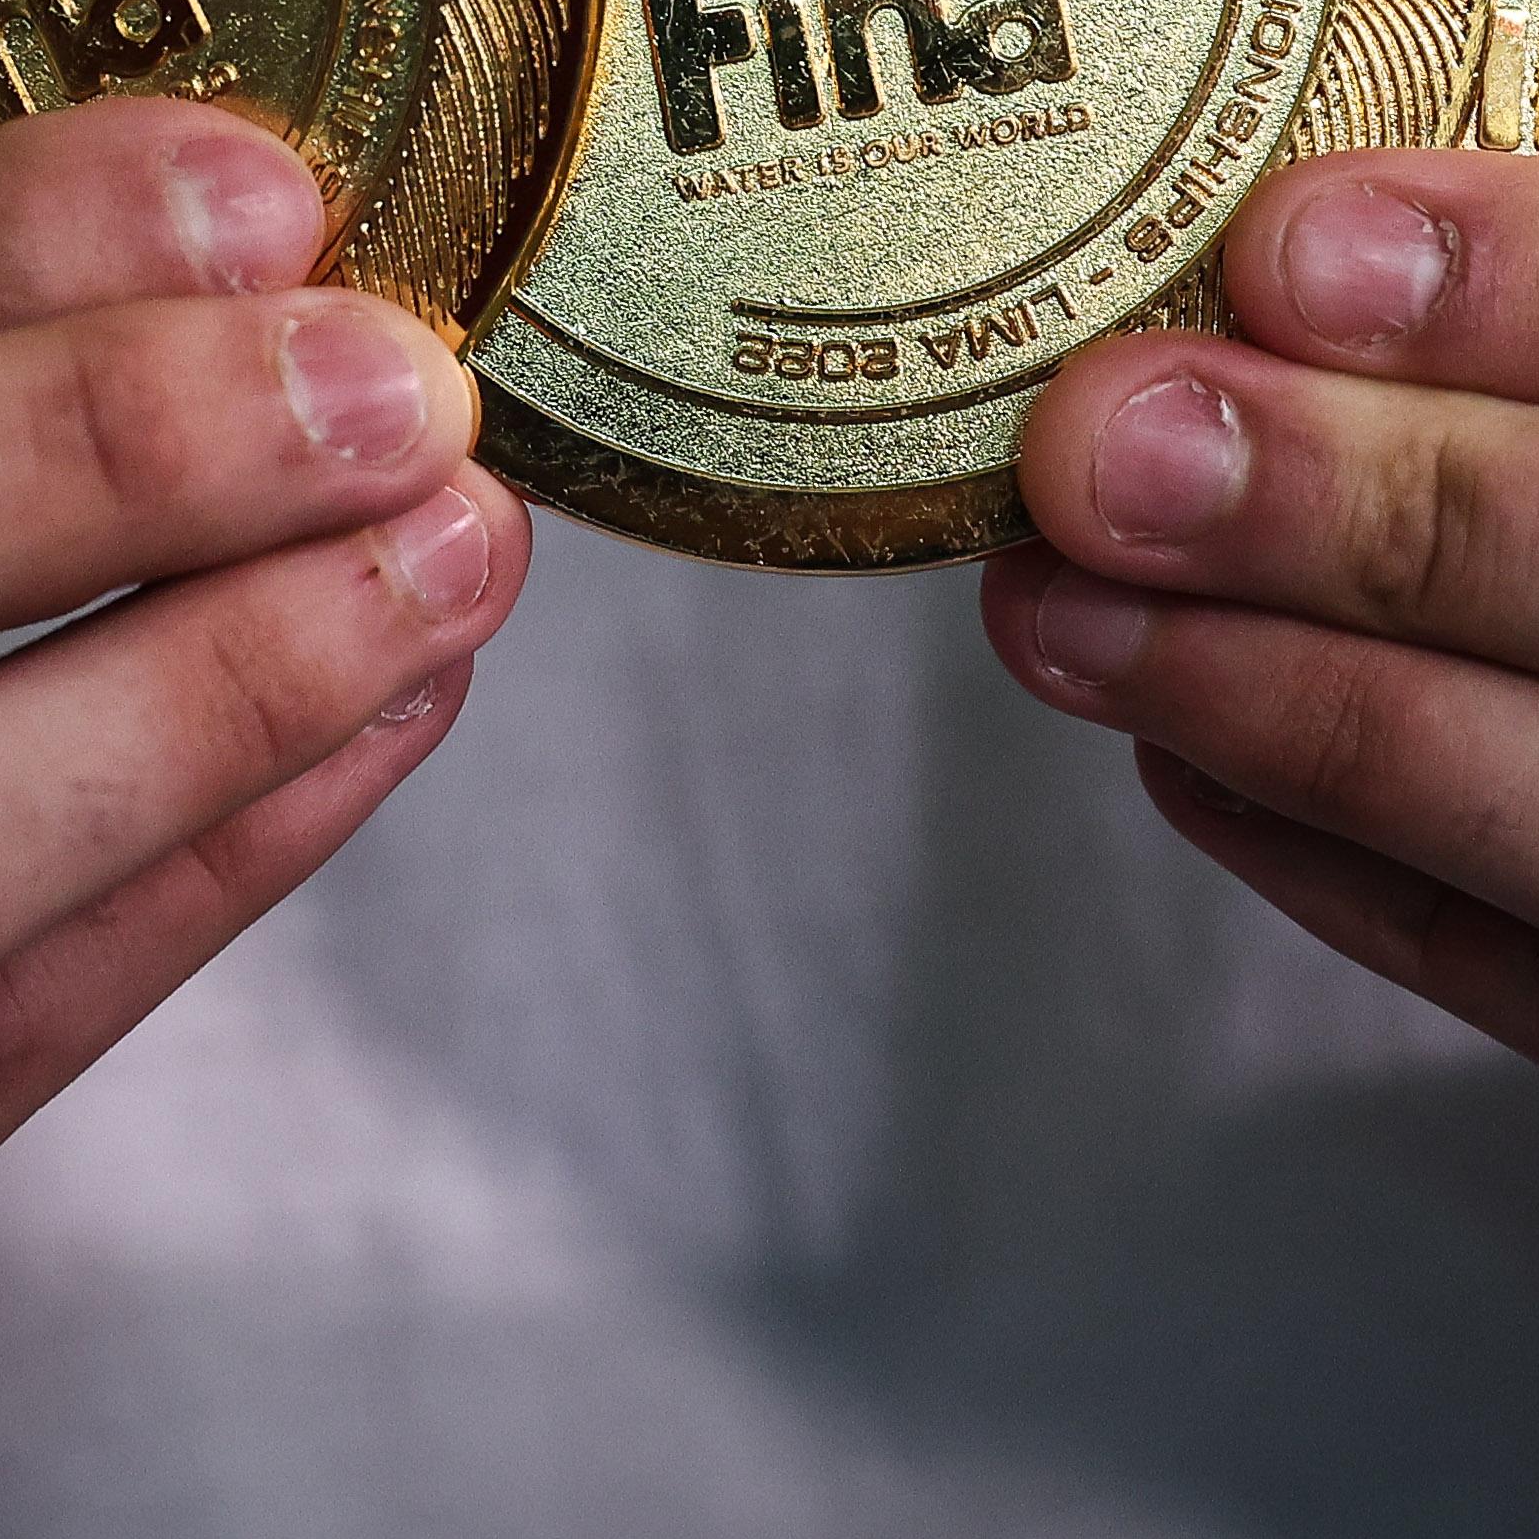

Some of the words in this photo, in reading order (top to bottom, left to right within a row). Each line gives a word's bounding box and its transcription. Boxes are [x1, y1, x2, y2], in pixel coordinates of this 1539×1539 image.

[672, 157, 804, 203] WATER
[814, 146, 856, 177] IS
[860, 131, 944, 170] OUR
[952, 101, 1094, 150] WORLD
[732, 331, 901, 382] 2022
[919, 281, 1078, 371] LIMA
